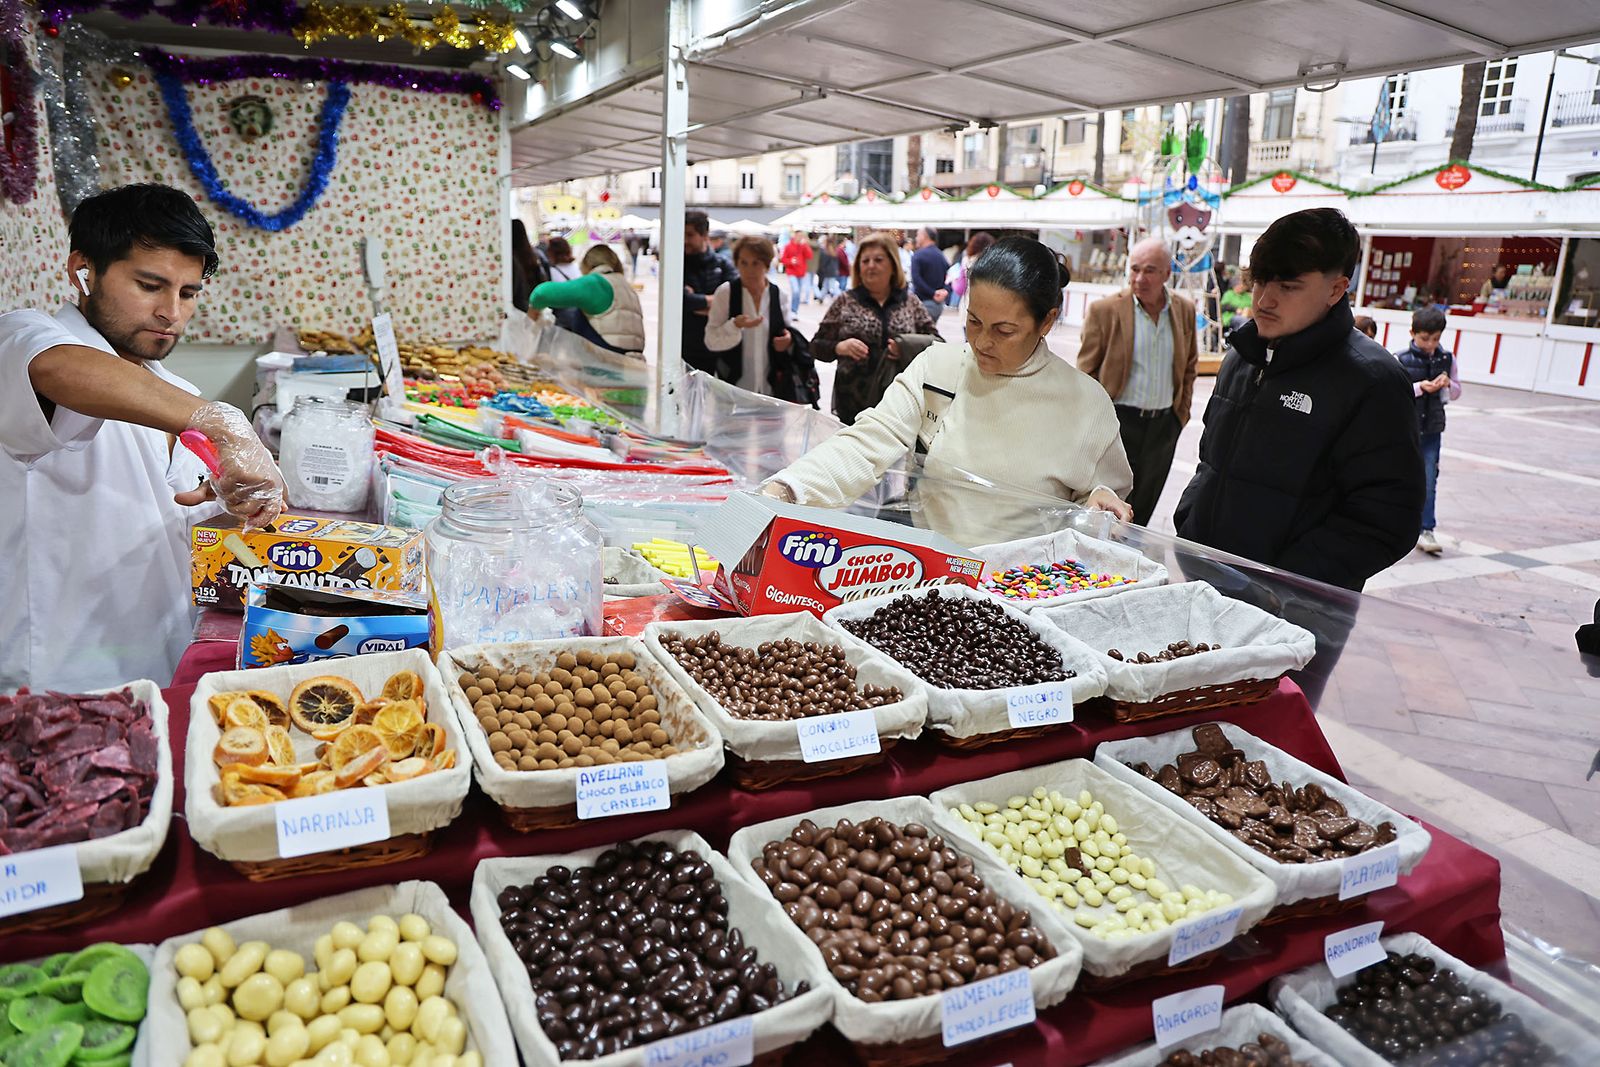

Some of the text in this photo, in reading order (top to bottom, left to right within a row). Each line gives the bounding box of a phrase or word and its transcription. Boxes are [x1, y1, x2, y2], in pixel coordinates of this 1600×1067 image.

[1291, 391, 1304, 400] THE
[197, 531, 217, 539] NEW
[272, 545, 317, 567] Fini
[783, 534, 840, 565] Fini
[847, 553, 894, 566] CHOCO
[828, 561, 917, 590] JUMBOS
[198, 586, 217, 597] 150
[765, 584, 825, 612] GIGANTESCO
[364, 642, 403, 651] VIDAL
[1018, 707, 1059, 723] NEGRO
[580, 765, 644, 786] AVELLANA
[578, 778, 665, 800] CHOCO BLANCO
[601, 796, 657, 813] CANELA
[1342, 855, 1399, 890] PLATANO
[1327, 931, 1378, 960] ARANDANO
[946, 971, 1028, 1016] ALMENDRA
[1157, 1002, 1219, 1032] ANACARDO
